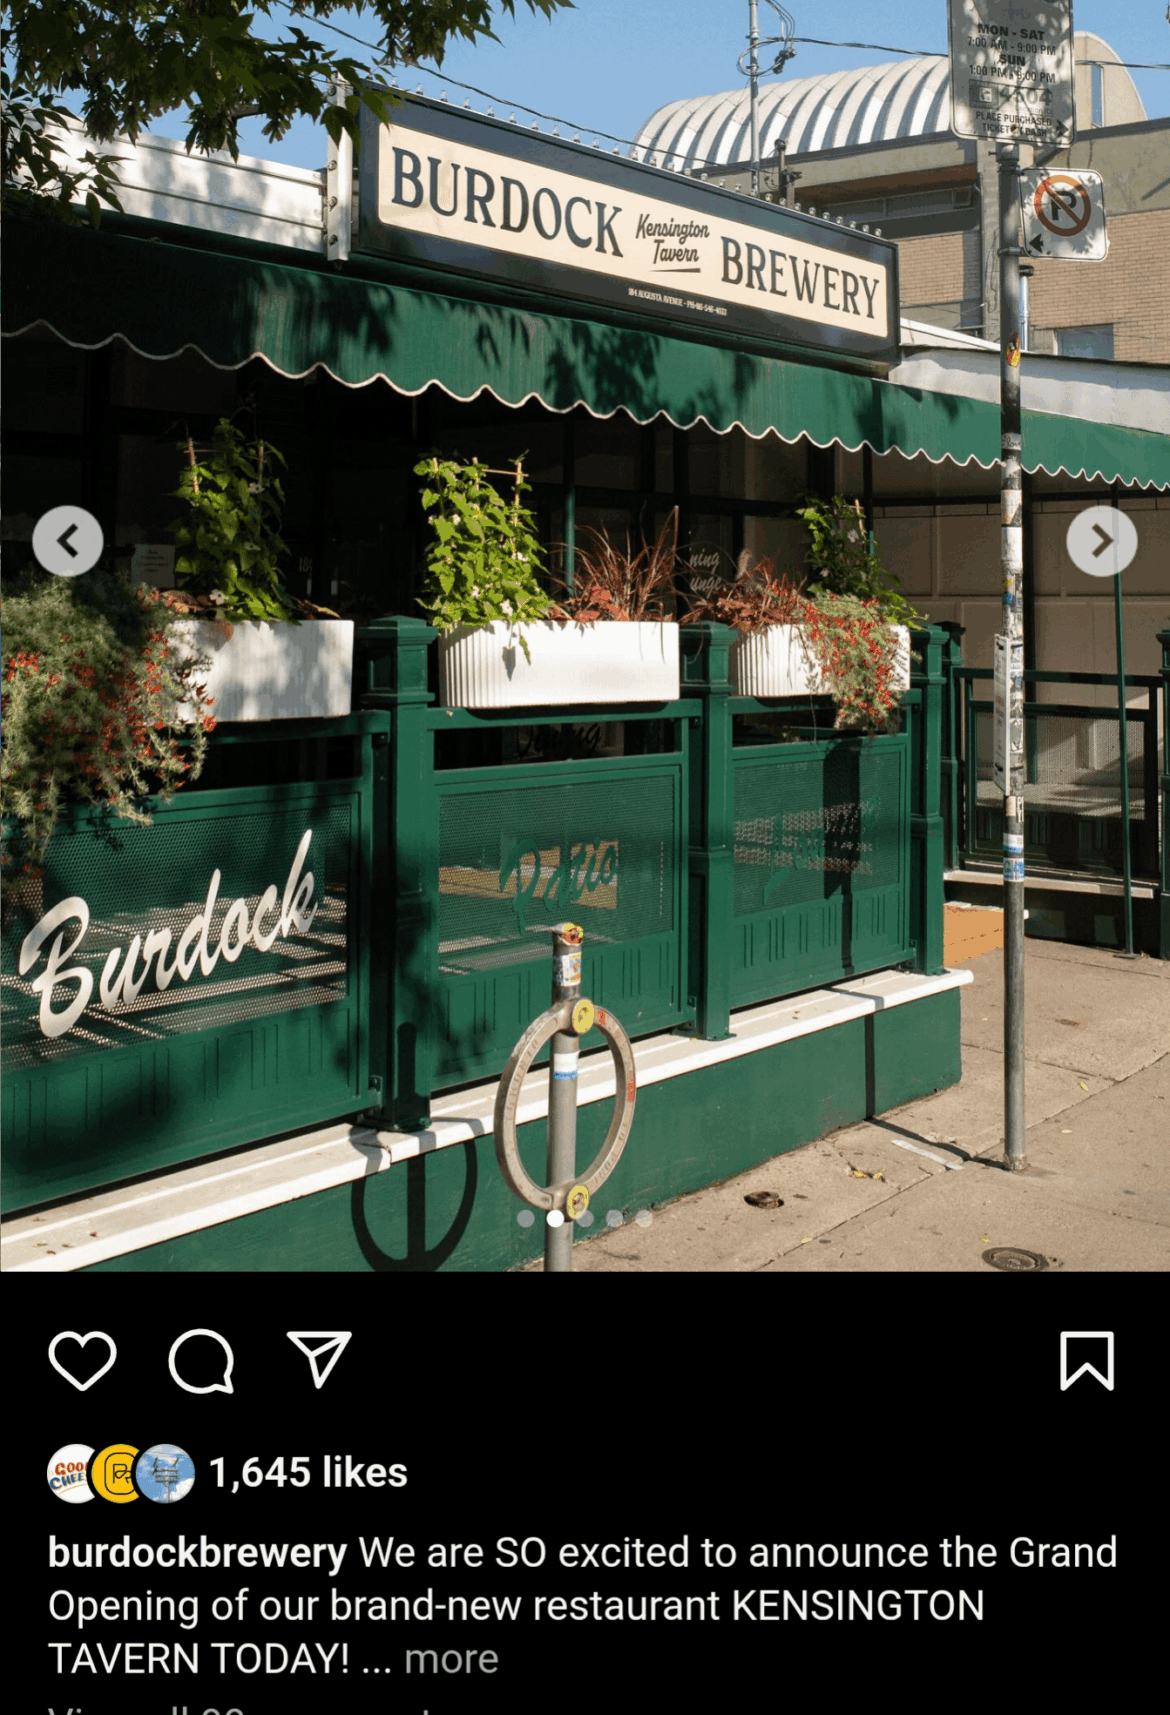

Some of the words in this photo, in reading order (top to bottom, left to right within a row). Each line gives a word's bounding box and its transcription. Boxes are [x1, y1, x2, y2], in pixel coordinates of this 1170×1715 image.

[978, 24, 1009, 36] MON
[1020, 28, 1045, 40] SAT
[968, 36, 987, 48] 7:00
[990, 39, 1008, 50] AM
[1017, 42, 1037, 54] 9:00
[1040, 45, 1056, 56] PM
[1000, 54, 1026, 66] SUN
[969, 65, 988, 76] 1:00
[1017, 66, 1037, 82] 9:00
[1040, 71, 1056, 83] PM
[975, 111, 1002, 122] PLACE
[1003, 114, 1053, 127] PURCHASED
[982, 123, 1010, 134] TICKET
[1025, 127, 1047, 138] DASH
[391, 146, 624, 258] BURDOCK
[635, 213, 710, 245] Kensington
[652, 239, 699, 265] Tavern
[720, 235, 880, 319] BREWERY
[638, 289, 662, 302] AUGUSTA
[663, 294, 683, 307] AVENUE
[18, 828, 319, 1038] Burdock
